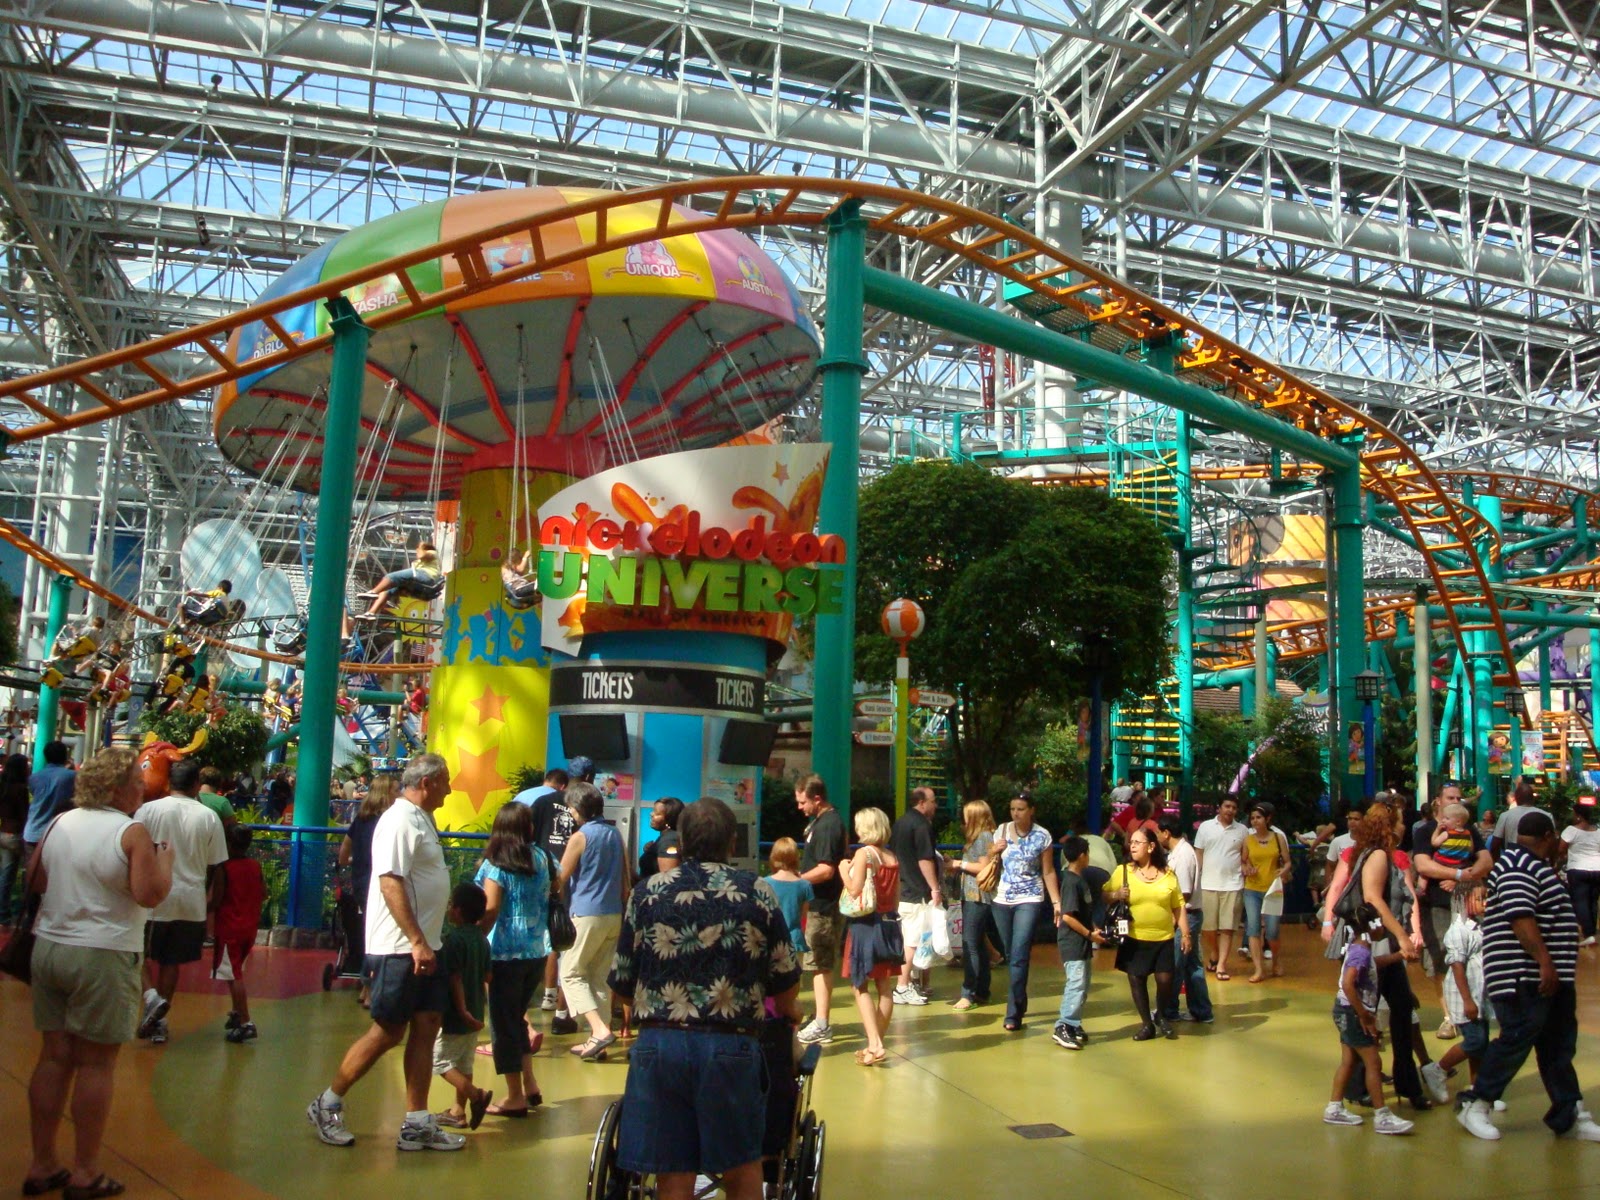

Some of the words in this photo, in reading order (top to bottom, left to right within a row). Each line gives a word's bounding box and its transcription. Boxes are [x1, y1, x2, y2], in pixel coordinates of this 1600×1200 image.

[626, 263, 681, 278] UNIQUA
[742, 279, 774, 297] AUSTIN
[352, 292, 399, 315] TASHA
[253, 338, 284, 359] PABLO
[536, 550, 846, 615] UNIVERSE
[582, 671, 634, 699] TICKETS
[716, 677, 754, 708] TICKETS
[553, 803, 572, 813] TRU
